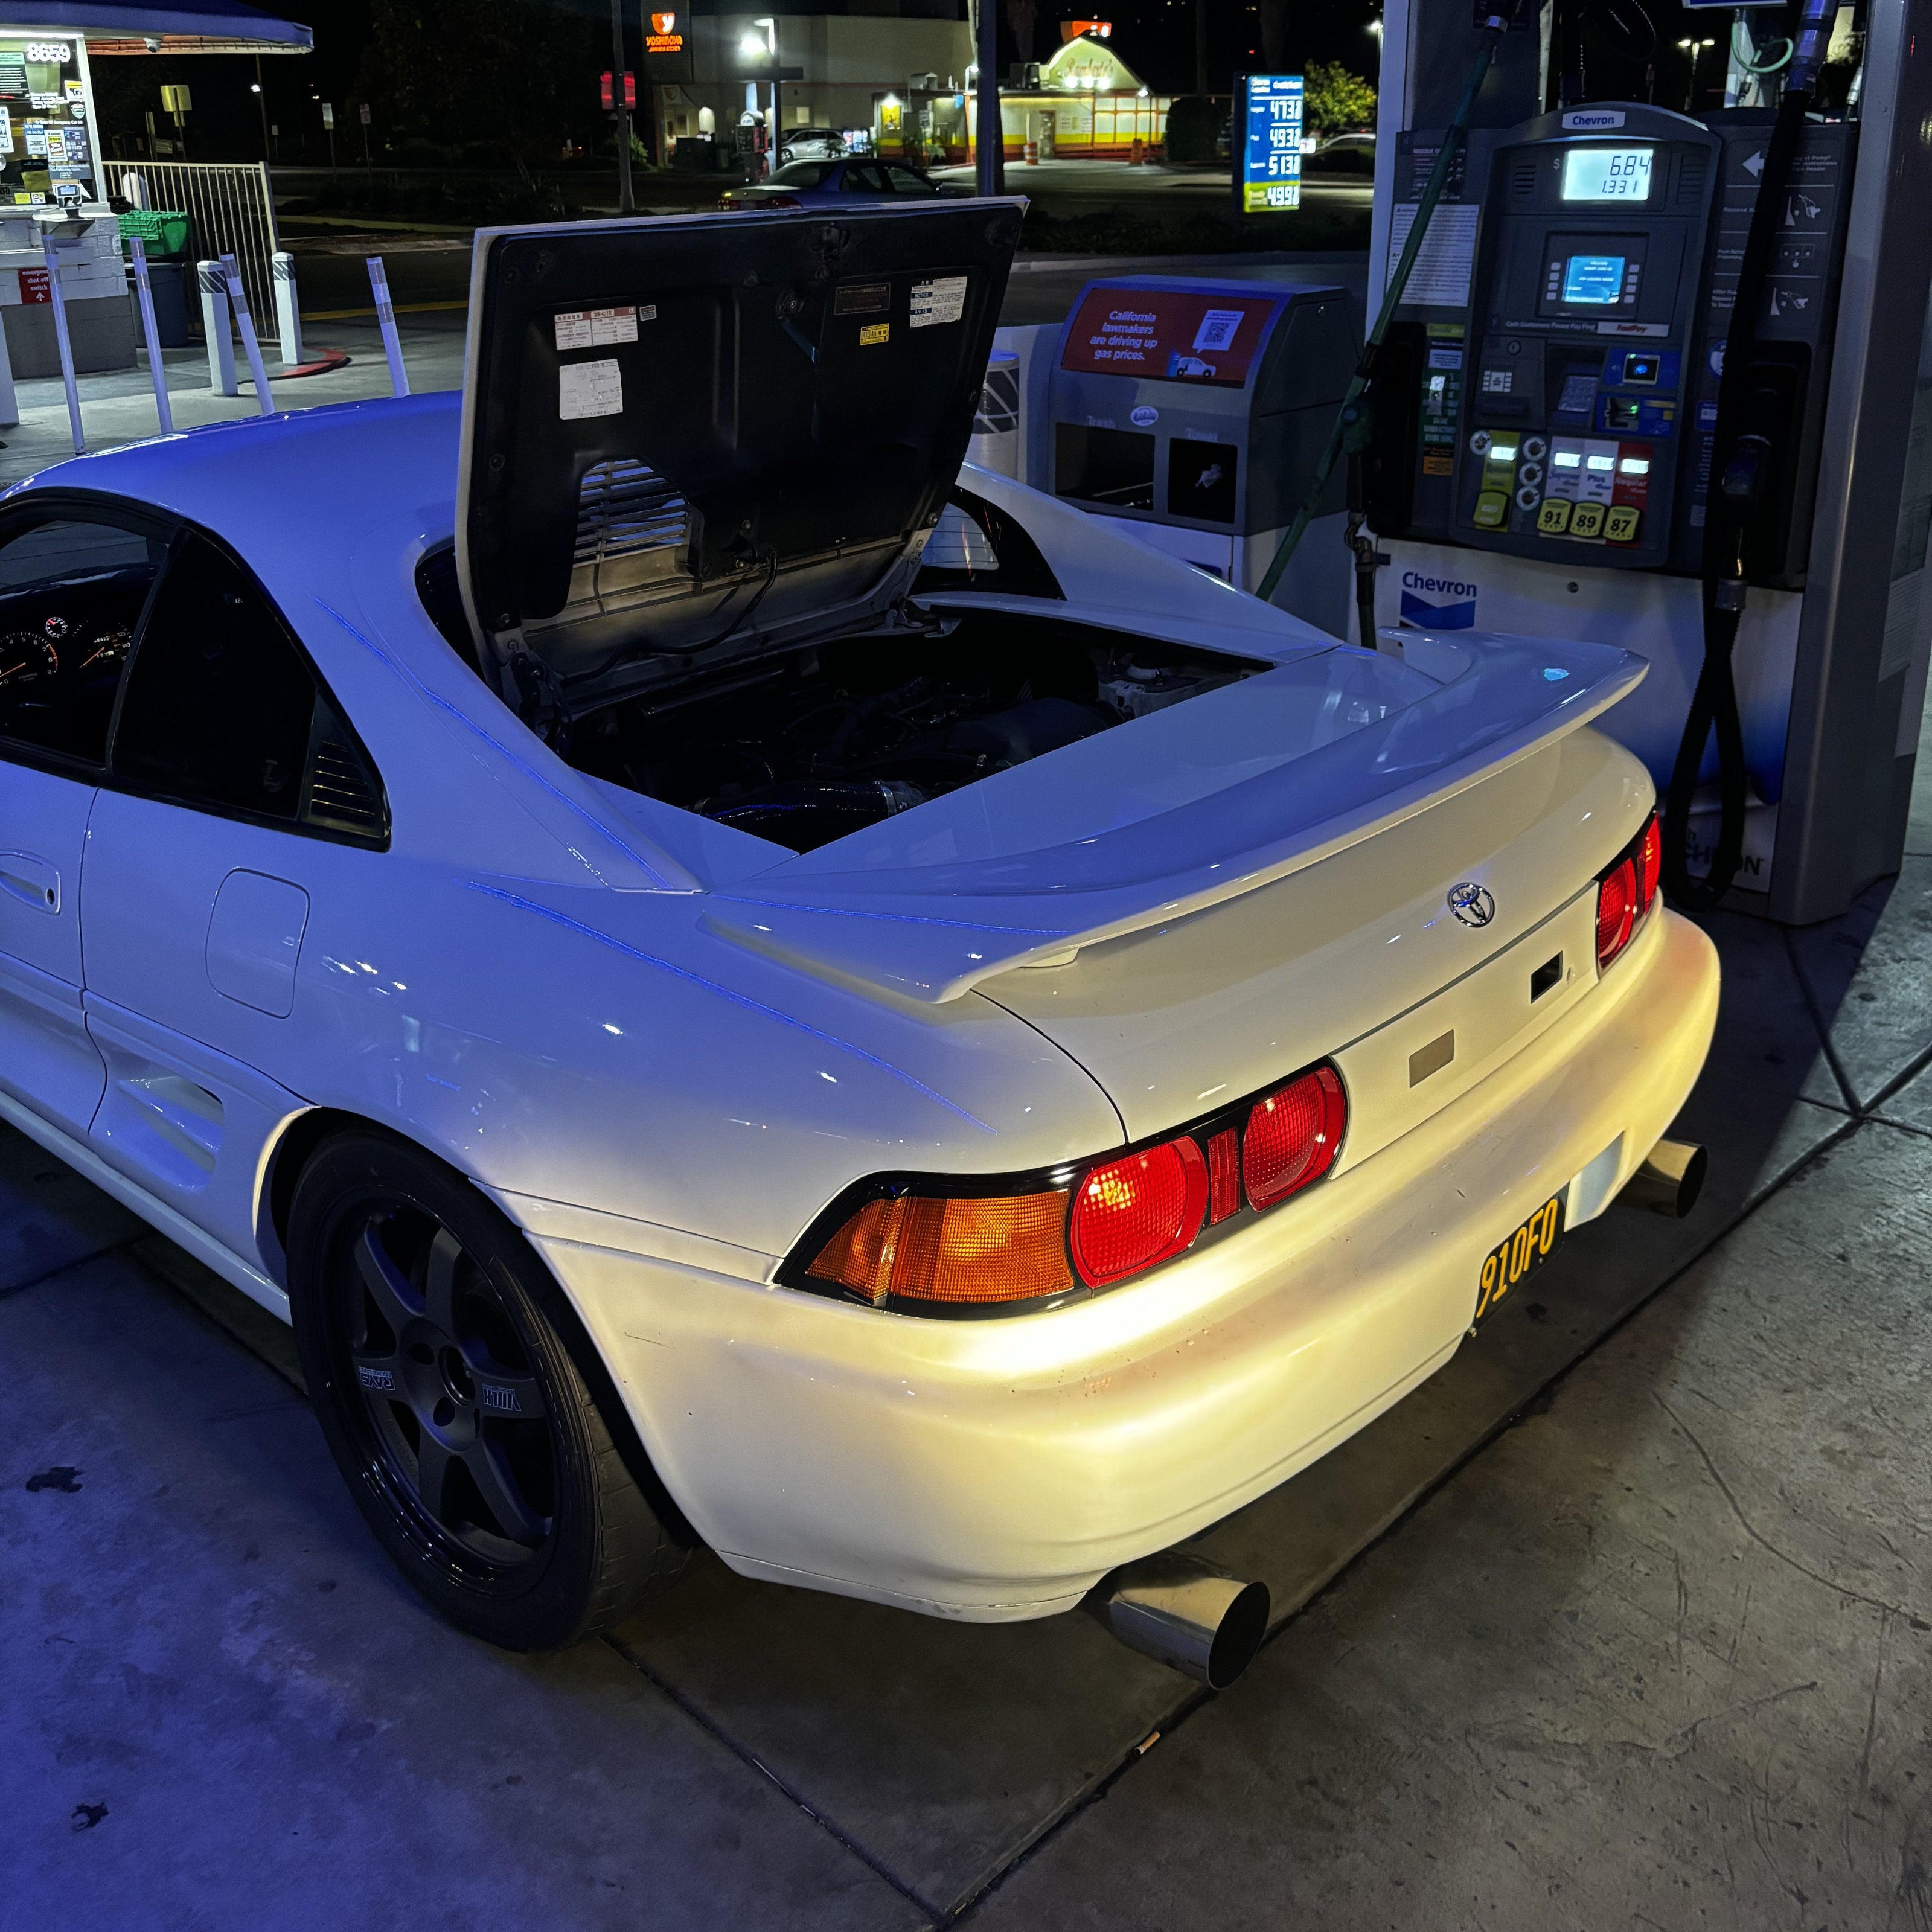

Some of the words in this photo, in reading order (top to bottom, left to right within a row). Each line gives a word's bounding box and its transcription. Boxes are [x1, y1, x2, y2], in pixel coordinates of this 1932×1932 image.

[27, 43, 71, 62] 8659
[1572, 115, 1614, 126] Chevron
[1108, 310, 1157, 322] California
[1101, 322, 1154, 335] lawmakers
[1089, 336, 1107, 345] are
[1107, 335, 1142, 349] driving
[1143, 339, 1158, 350] up
[1093, 350, 1112, 360] gas
[1112, 349, 1145, 360] prices.
[1587, 474, 1605, 483] Plus
[1544, 511, 1561, 525] 91
[1576, 514, 1596, 529] 89
[1610, 519, 1631, 533] 87
[1402, 572, 1477, 597] Chevron
